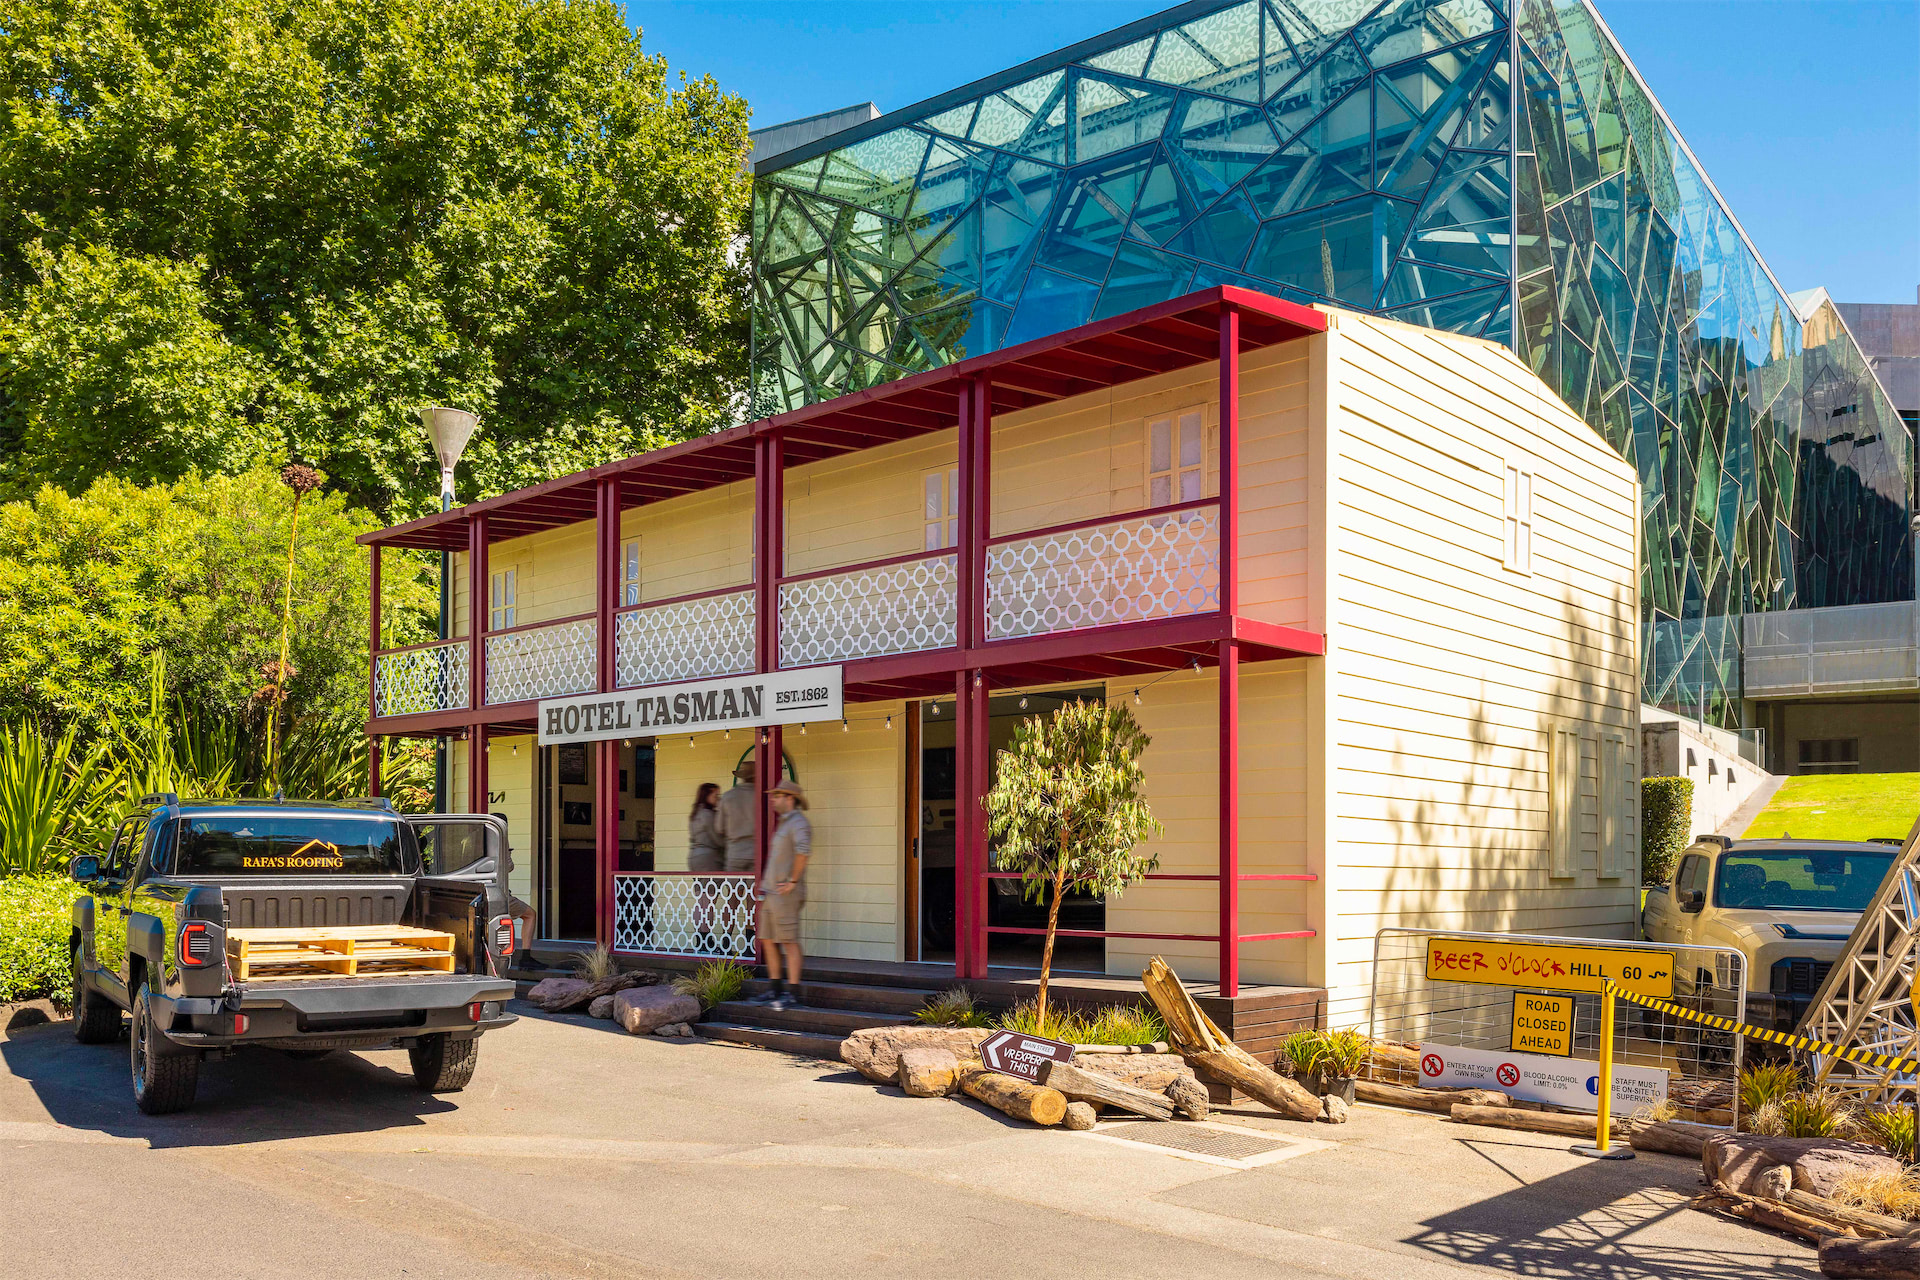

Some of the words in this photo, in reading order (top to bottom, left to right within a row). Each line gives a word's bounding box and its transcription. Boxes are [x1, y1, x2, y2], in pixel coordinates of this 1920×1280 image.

[546, 701, 631, 735] HOTEL
[637, 685, 763, 727] TASMAN
[243, 857, 285, 867] RAFA'S
[286, 857, 343, 867] ROOFING
[1433, 950, 1489, 973] BEER
[1497, 952, 1566, 978] O'CLOCK
[1570, 962, 1608, 978] HILL
[1622, 966, 1642, 980] 60
[1526, 999, 1560, 1013] ROAD
[1517, 1016, 1567, 1032] CLOSED
[1023, 1041, 1036, 1049] MAIN
[1036, 1044, 1055, 1053] STREET
[1519, 1035, 1562, 1050] AHEAD
[1003, 1047, 1015, 1059] VR
[1014, 1050, 1051, 1066] EXPERI
[1009, 1060, 1029, 1074] THIS
[1446, 1061, 1467, 1070] ENTER
[1476, 1065, 1494, 1073] YOUR
[1454, 1069, 1470, 1077] OWN
[1523, 1071, 1547, 1080] BLOOD
[1547, 1074, 1579, 1084] ALCOHOL
[1615, 1077, 1637, 1086] STAFF
[1637, 1080, 1658, 1089] MUST
[1533, 1080, 1552, 1088] LIMIT:
[1552, 1082, 1568, 1090] 0.0%
[1611, 1084, 1621, 1092] BE
[1621, 1086, 1650, 1096] ON-SITE
[1650, 1089, 1661, 1097] TO
